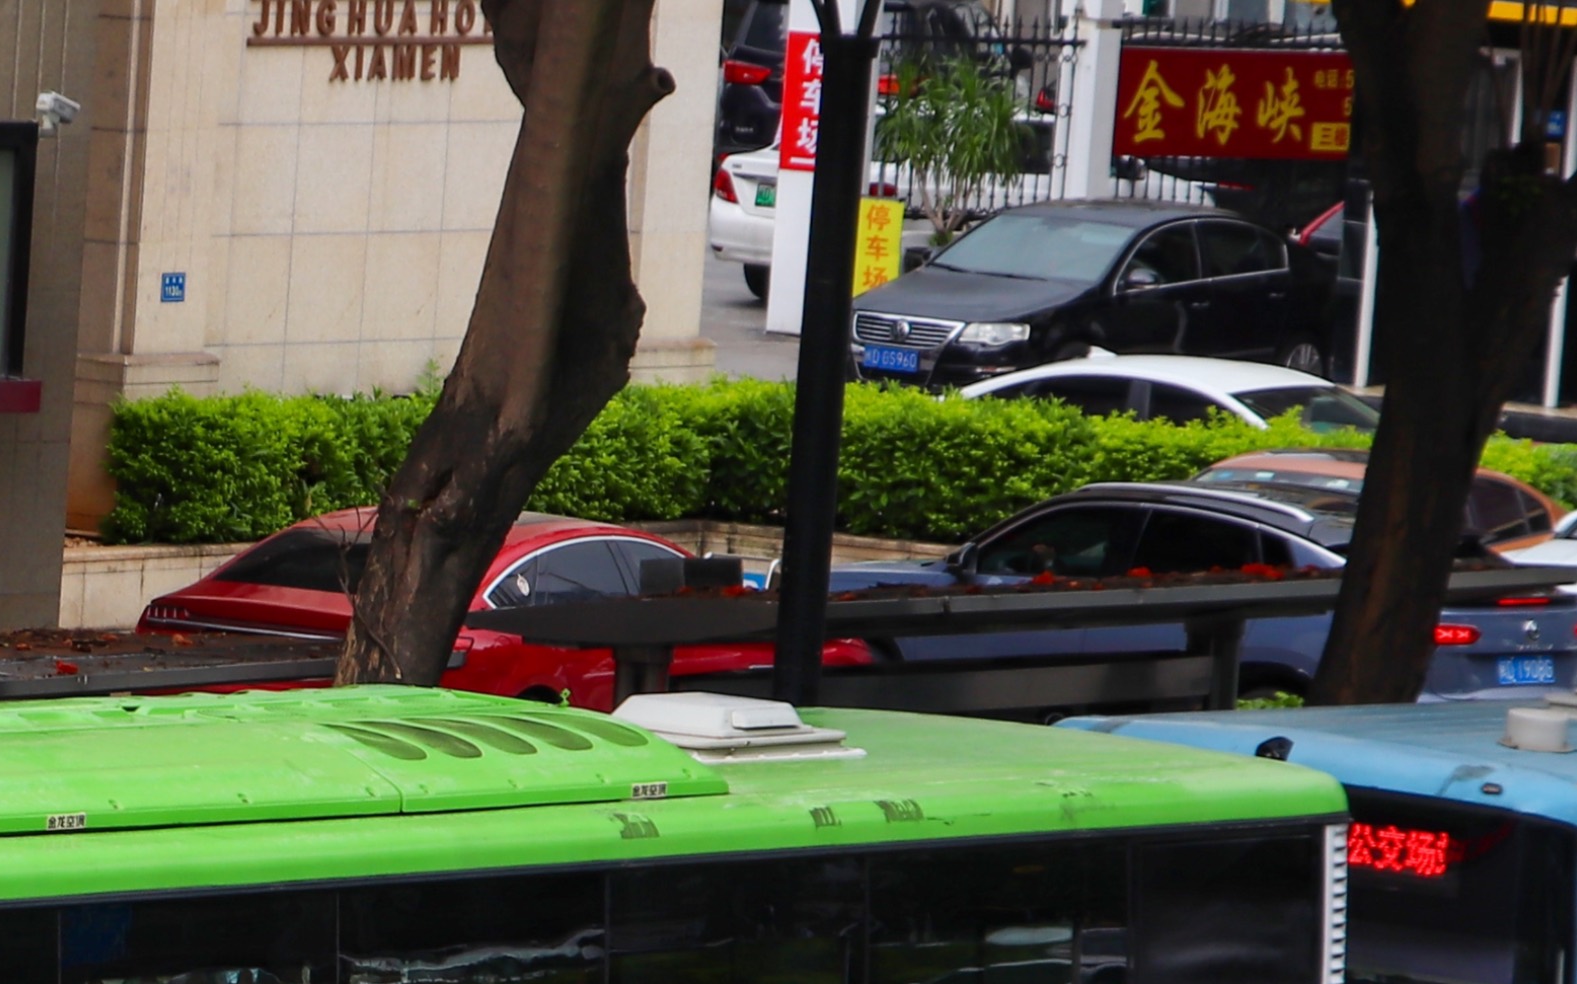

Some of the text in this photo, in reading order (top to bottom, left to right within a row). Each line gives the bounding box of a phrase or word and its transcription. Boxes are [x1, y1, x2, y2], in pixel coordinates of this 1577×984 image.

[328, 43, 461, 83] XIAMEN
[1124, 59, 1305, 146] 金海峡
[862, 204, 891, 288] 停车场
